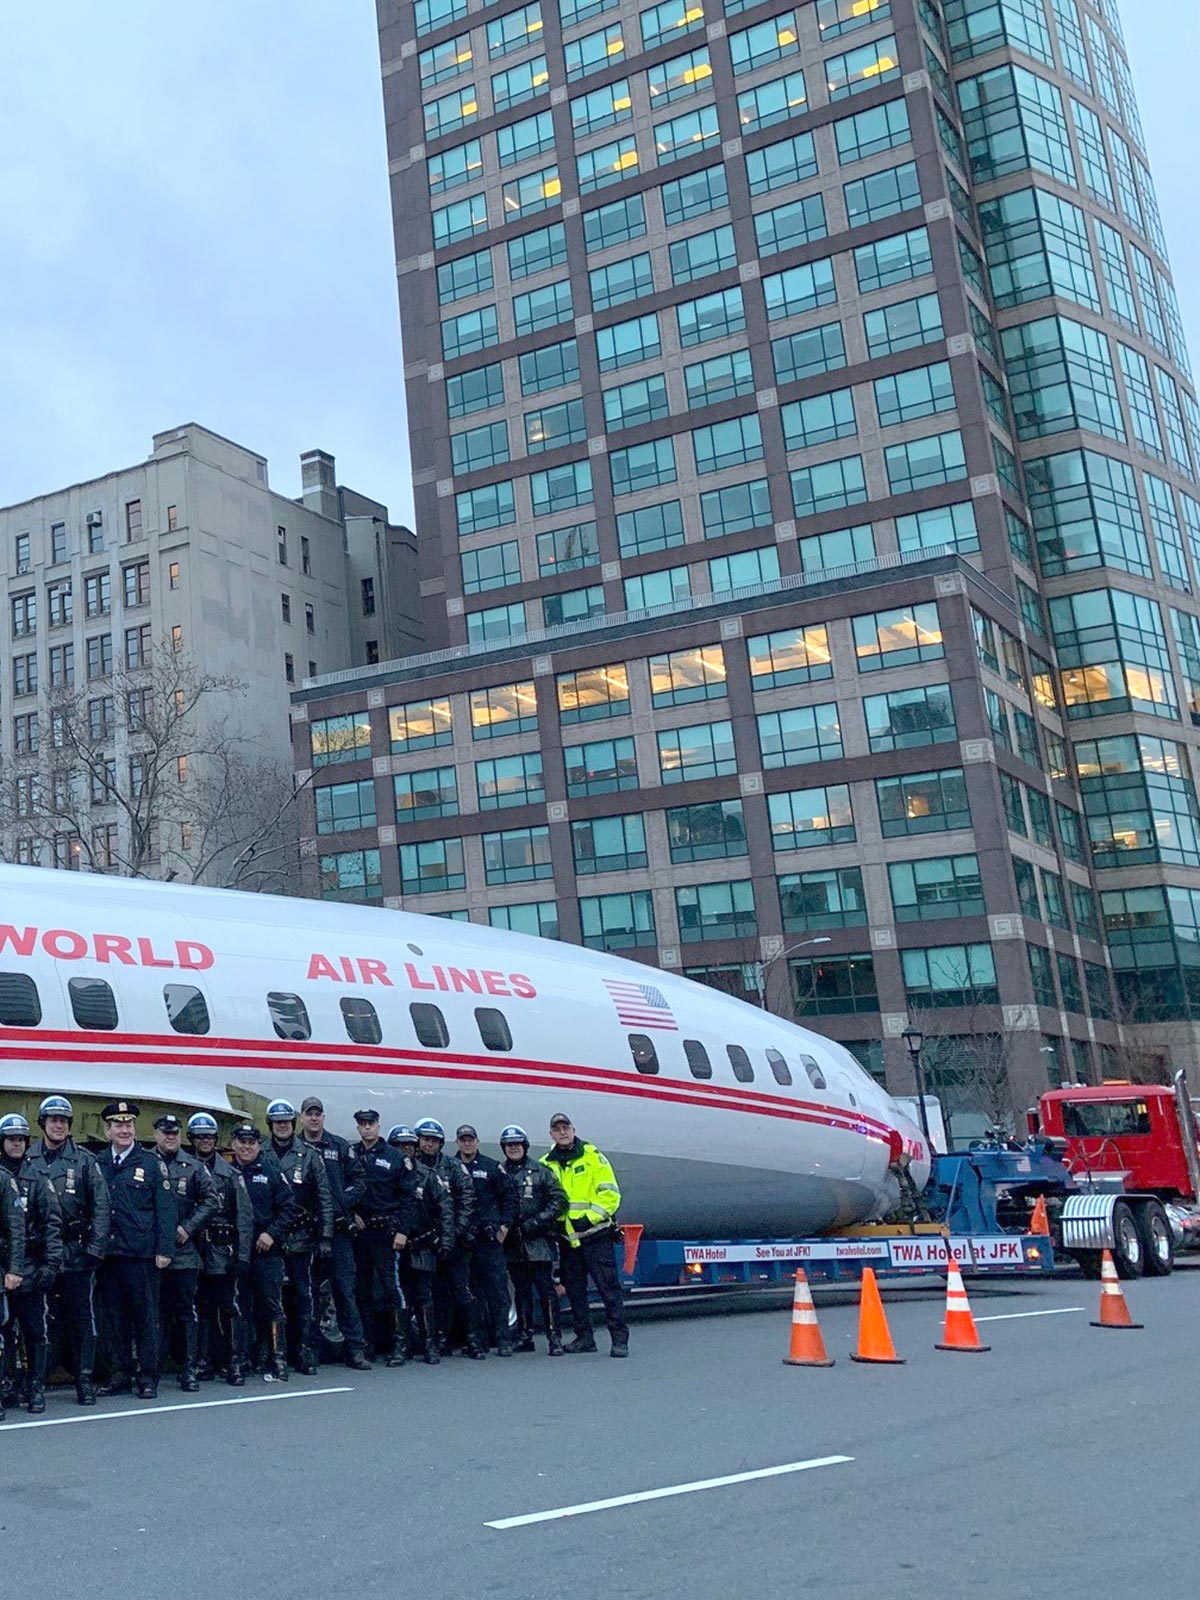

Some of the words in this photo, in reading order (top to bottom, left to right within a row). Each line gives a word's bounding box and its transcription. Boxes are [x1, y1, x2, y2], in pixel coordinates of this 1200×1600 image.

[307, 953, 390, 986] AIR
[406, 964, 537, 999] LINES
[686, 1248, 704, 1260] TWA
[705, 1248, 727, 1260] Hotel
[756, 1246, 770, 1257] See
[771, 1246, 785, 1257] You
[785, 1247, 793, 1257] at
[794, 1245, 811, 1257] JFK!
[836, 1244, 882, 1256] twahotel.com
[892, 1245, 923, 1261] TWA
[971, 1245, 985, 1259] at
[990, 1243, 1019, 1259] JFK
